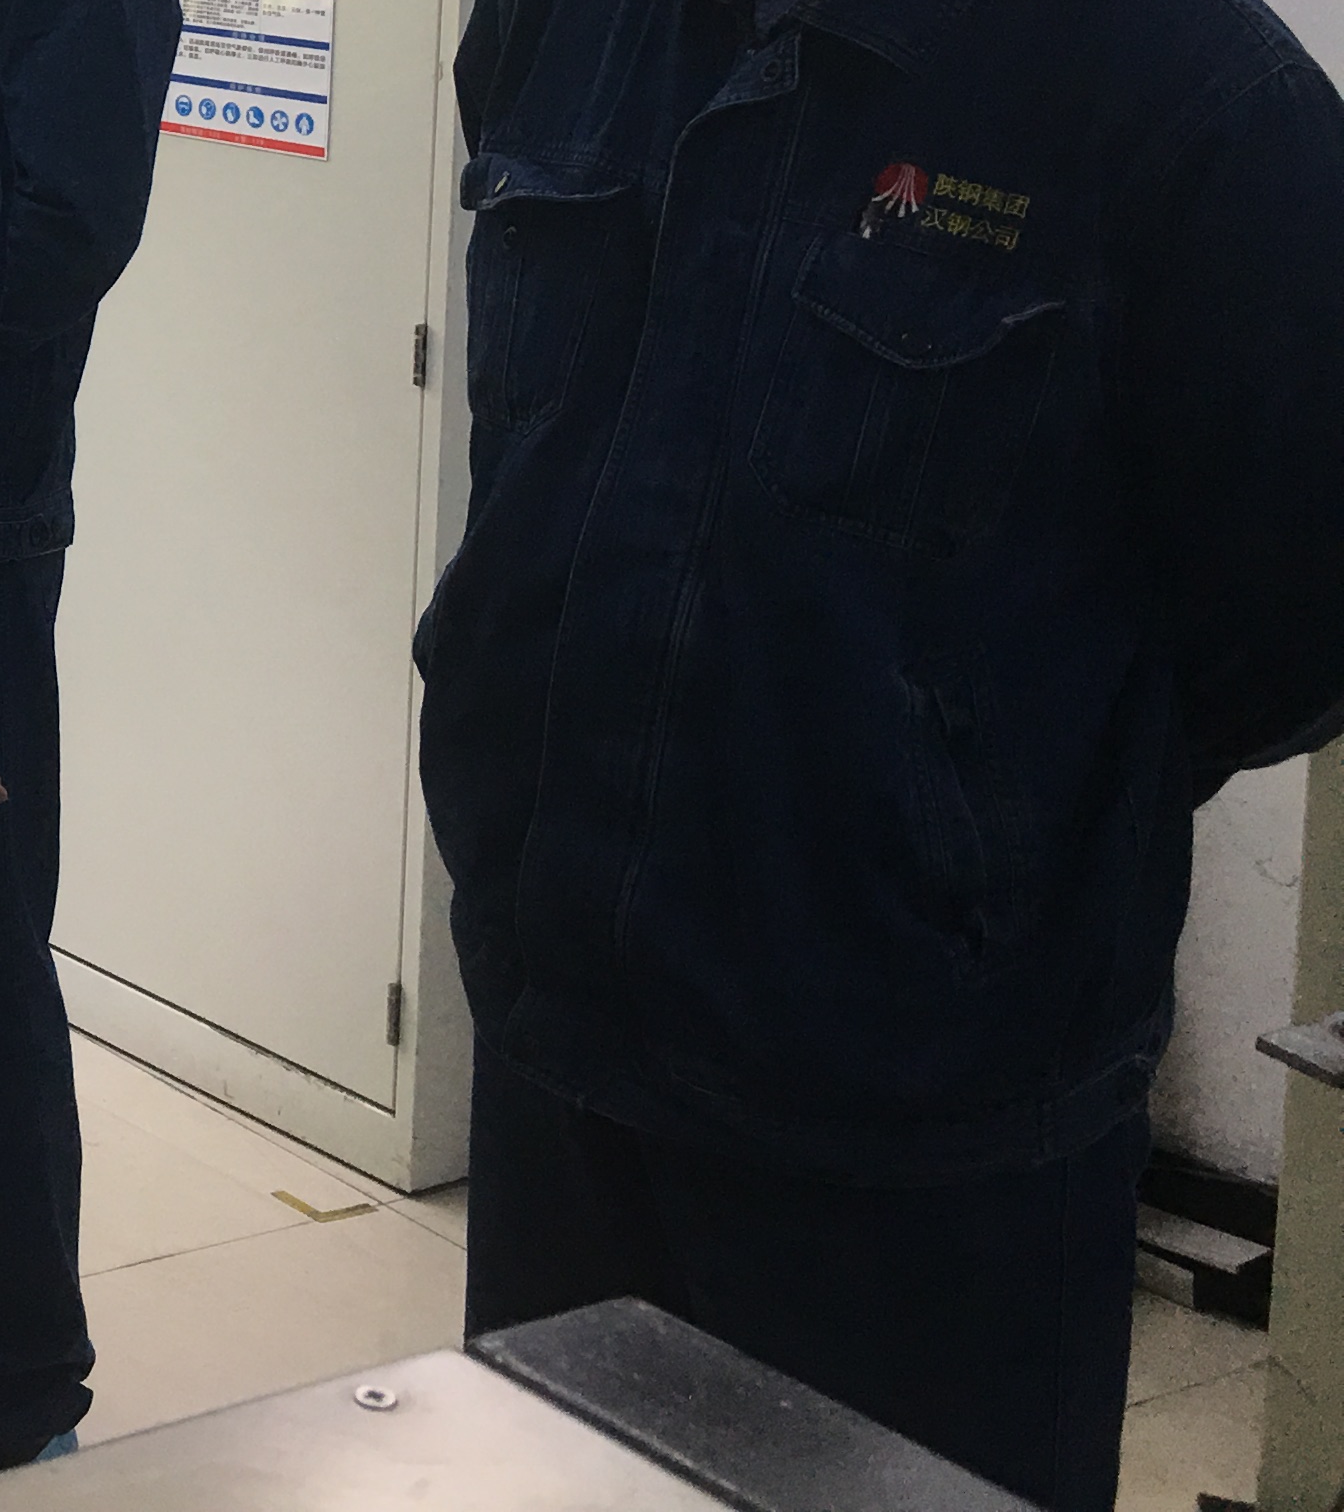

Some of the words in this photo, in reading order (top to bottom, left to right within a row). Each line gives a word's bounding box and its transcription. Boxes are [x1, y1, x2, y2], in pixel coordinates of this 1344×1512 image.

[933, 173, 1030, 219] 陕钢集团
[921, 205, 1021, 250] 汉钢公司
